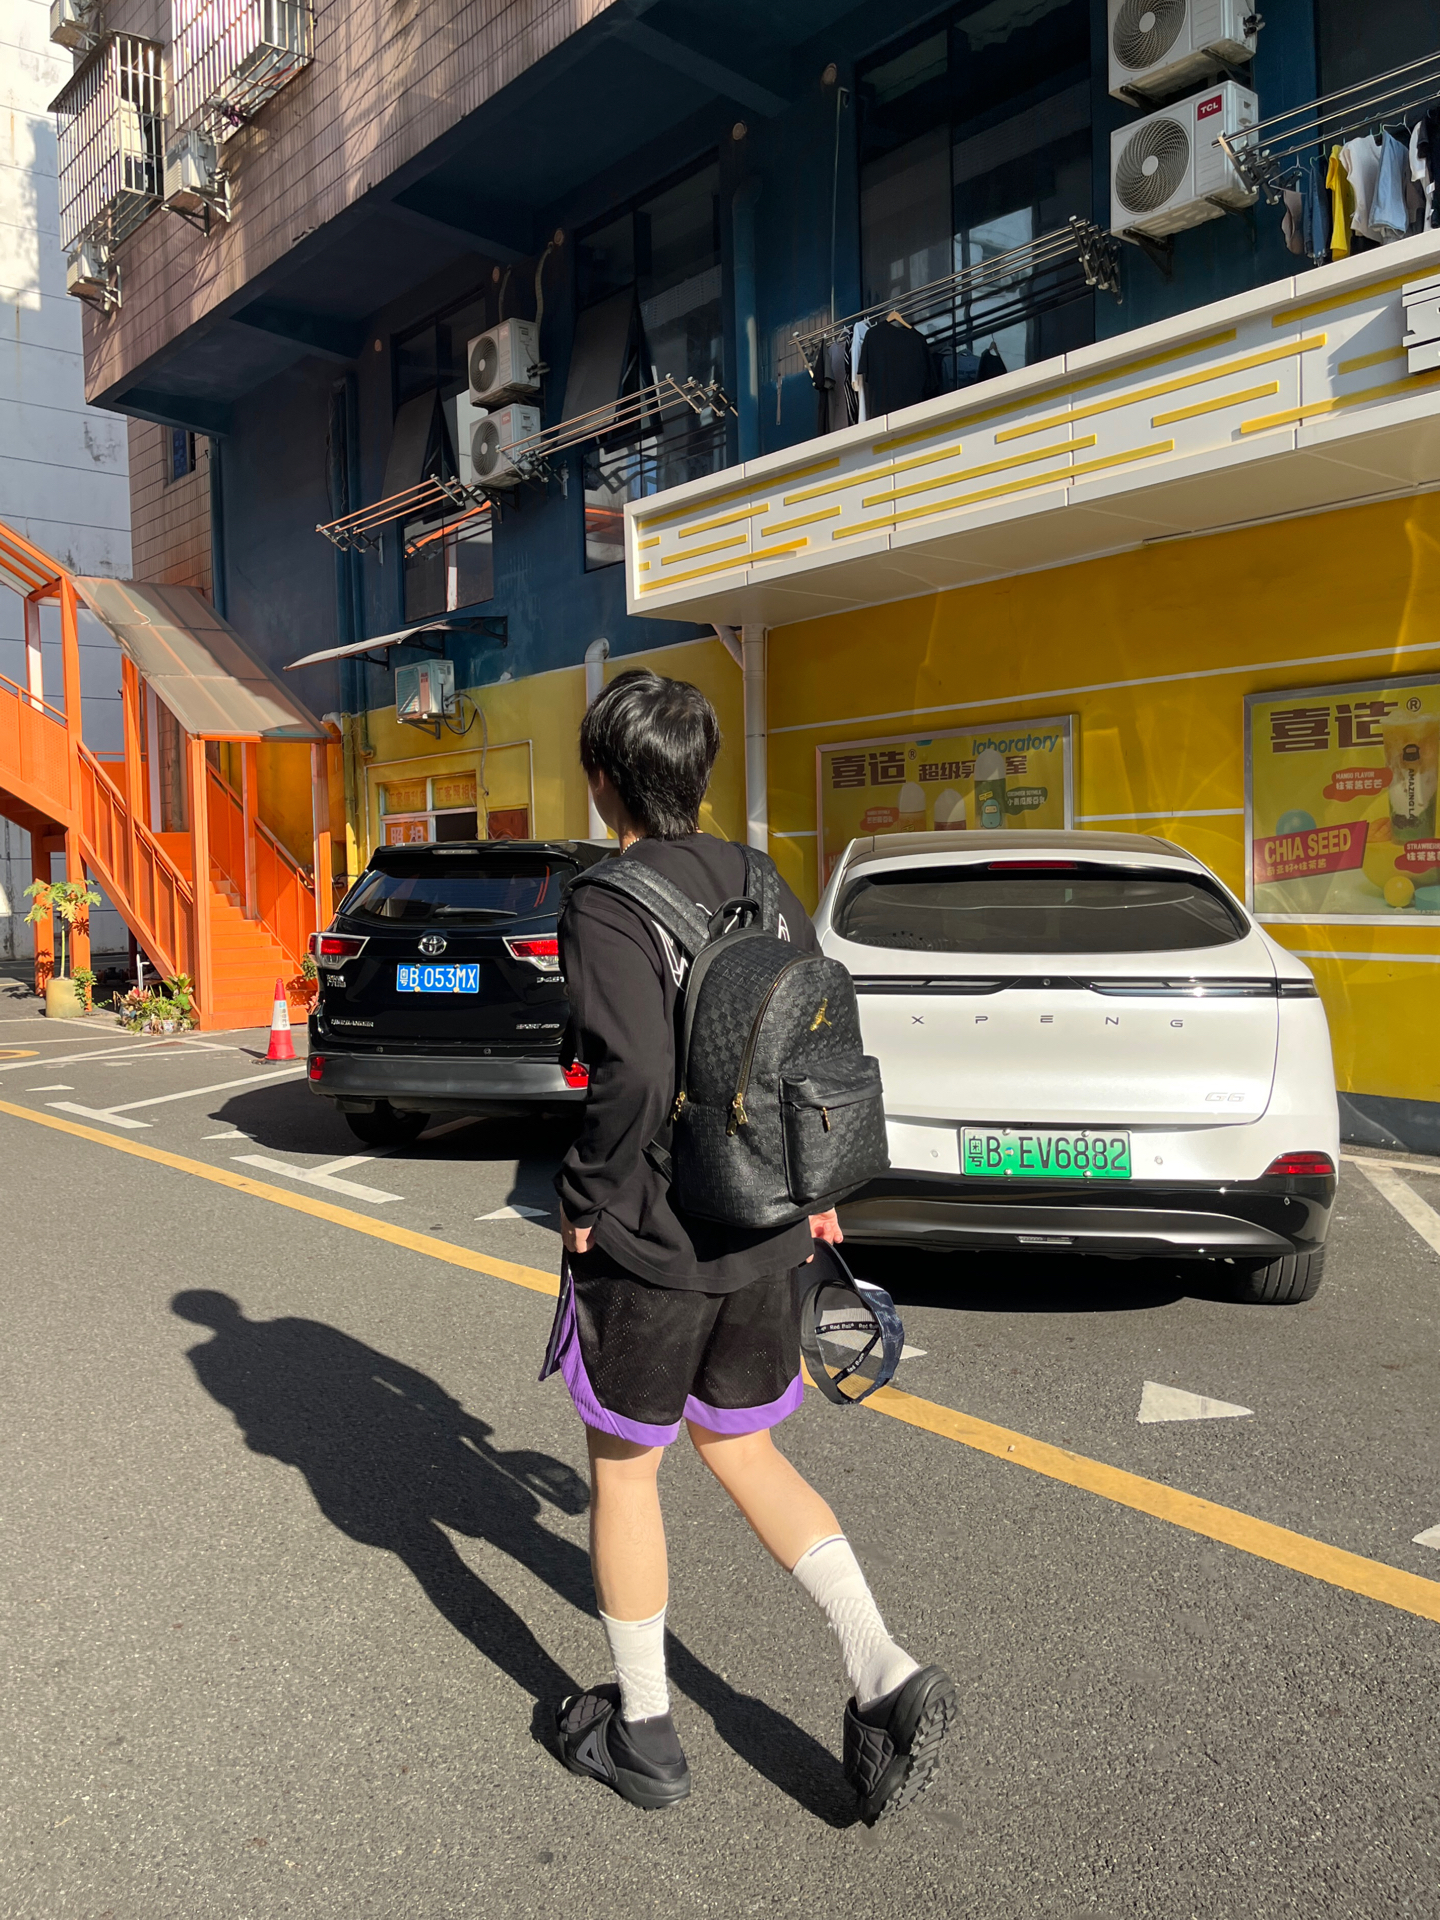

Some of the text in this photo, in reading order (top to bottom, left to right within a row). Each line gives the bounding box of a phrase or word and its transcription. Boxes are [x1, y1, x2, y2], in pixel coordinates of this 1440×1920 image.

[1201, 102, 1218, 113] TCL
[1270, 701, 1398, 753] 喜造
[972, 734, 1058, 756] laboratory
[831, 751, 906, 788] 喜造
[1264, 828, 1351, 864] CHIA SEED
[912, 1015, 1184, 1028] XPENG
[1205, 1092, 1246, 1103] G6
